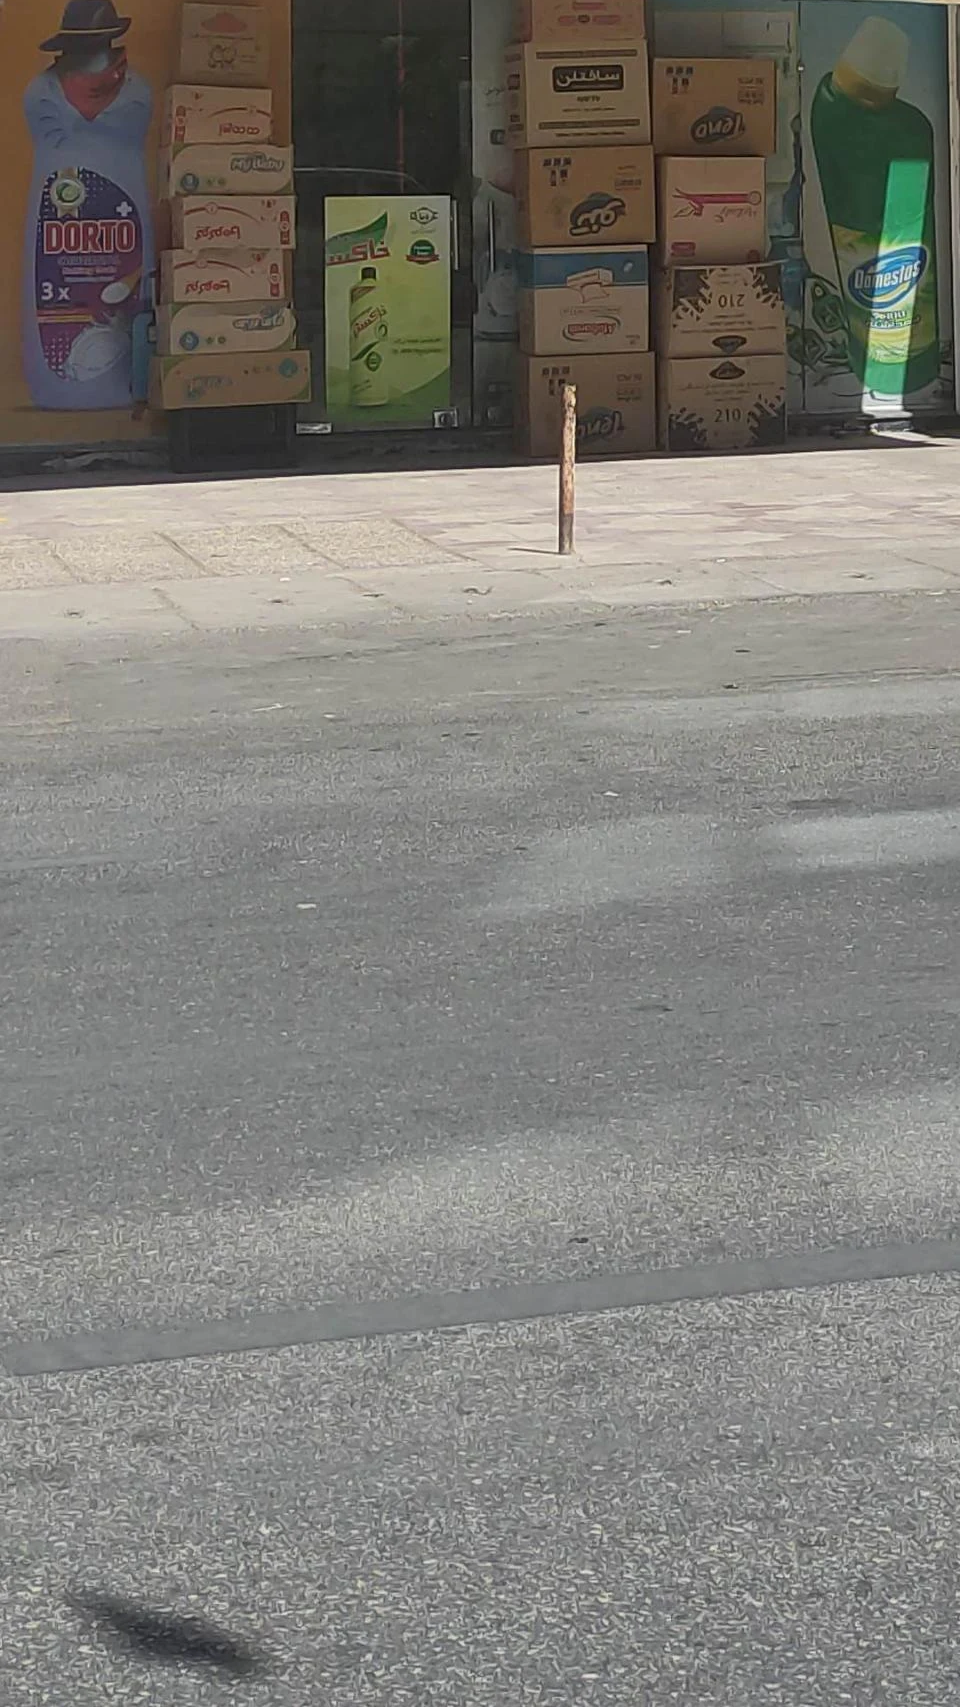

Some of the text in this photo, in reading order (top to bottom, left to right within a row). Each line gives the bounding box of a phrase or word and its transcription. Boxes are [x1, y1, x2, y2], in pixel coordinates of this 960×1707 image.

[43, 219, 136, 254] DORTO
[854, 260, 921, 290] Domestos
[718, 294, 745, 309] 210
[714, 408, 742, 423] 210
